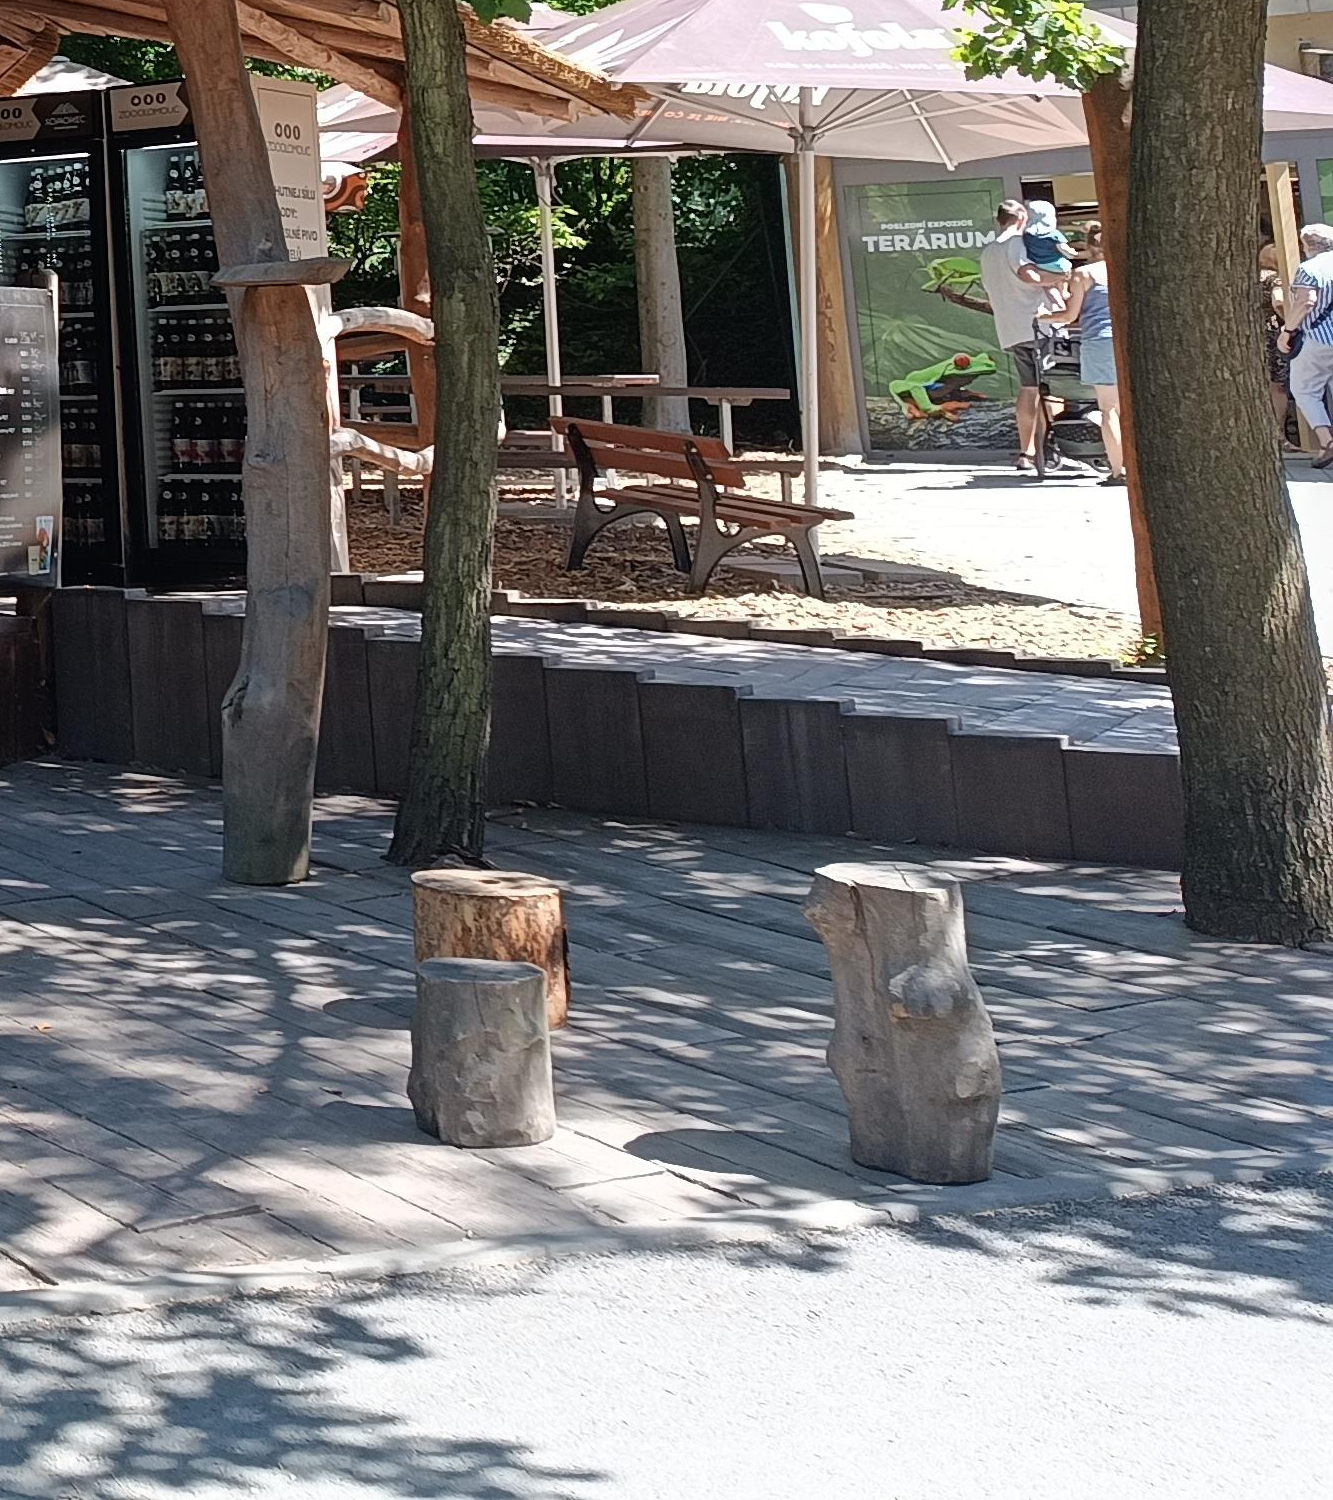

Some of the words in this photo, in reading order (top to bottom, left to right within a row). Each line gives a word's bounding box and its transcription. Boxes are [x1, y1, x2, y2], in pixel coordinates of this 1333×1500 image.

[285, 225, 301, 240] SLNÉ
[302, 230, 318, 242] PIVO
[881, 220, 926, 230] POSLEDNÍ
[927, 220, 973, 228] EXPOZICE
[862, 229, 996, 253] TERÁRIUM
